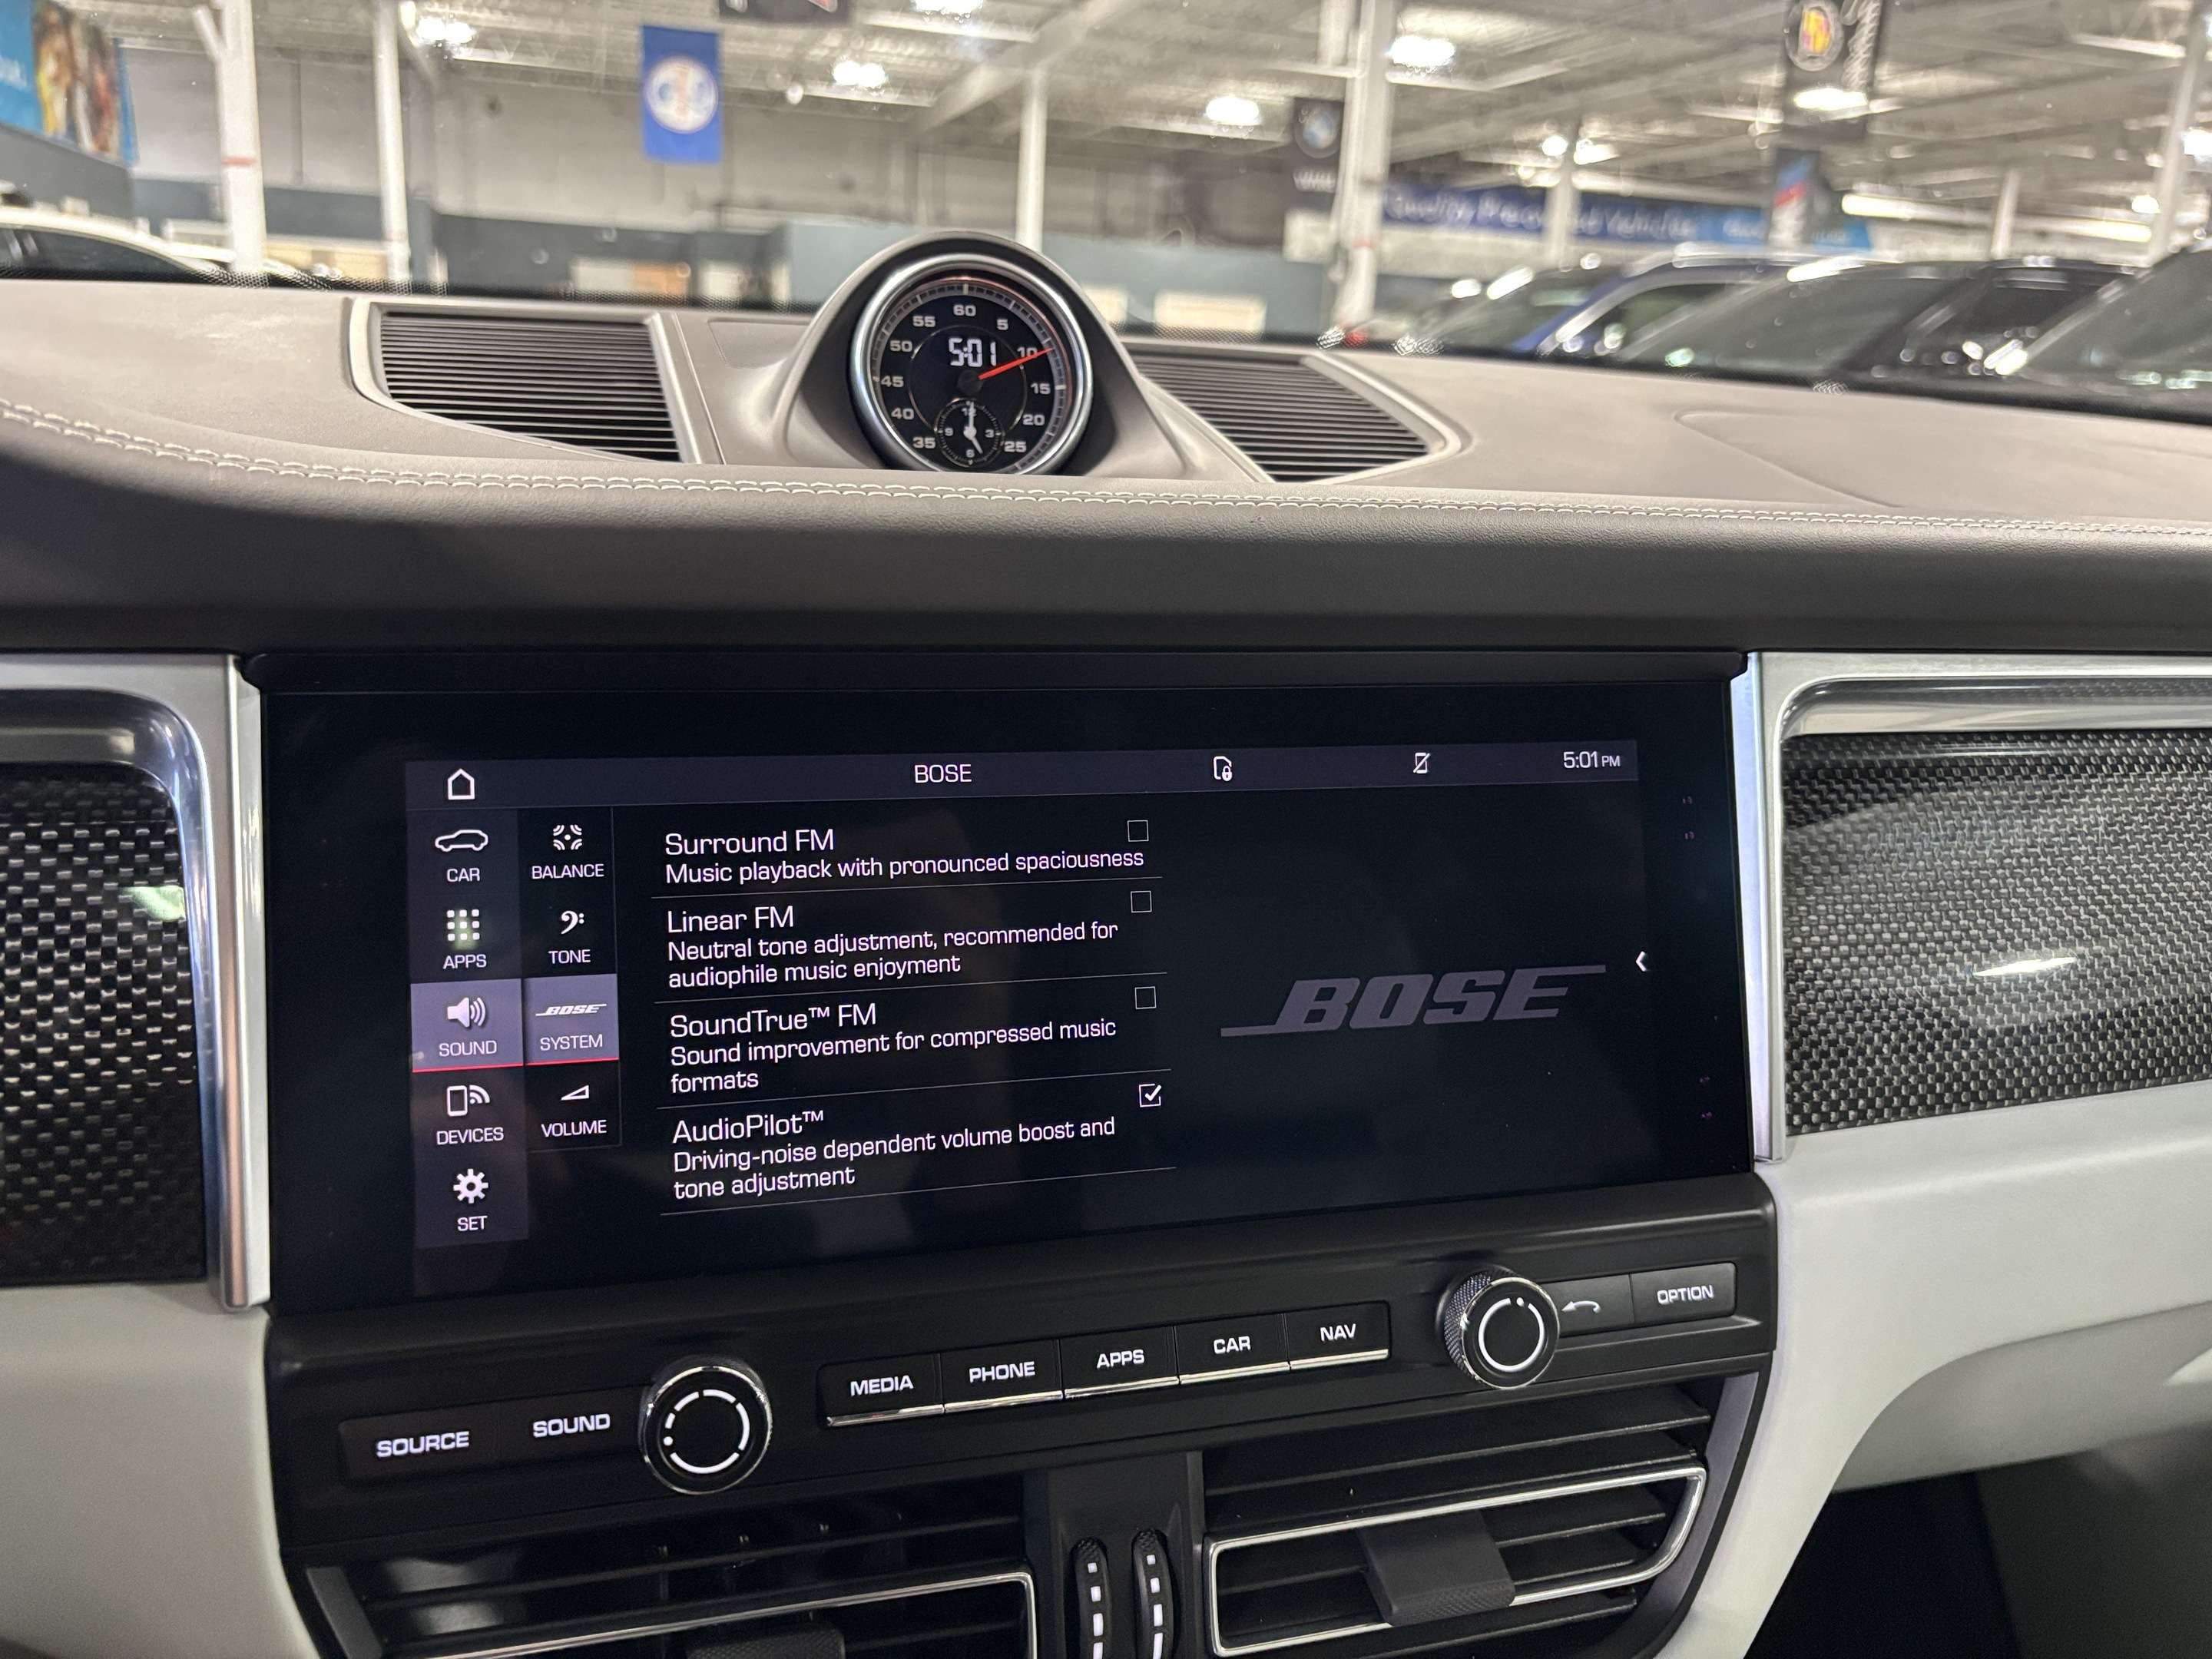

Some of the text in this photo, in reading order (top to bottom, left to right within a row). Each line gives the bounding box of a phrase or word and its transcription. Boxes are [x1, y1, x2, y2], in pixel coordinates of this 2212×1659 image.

[953, 304, 976, 317] 60
[912, 315, 936, 328] 55
[996, 318, 1008, 330] 5
[890, 340, 912, 352] 50
[949, 338, 997, 367] 5:01
[881, 376, 904, 387] 45
[1030, 382, 1051, 395] 15
[891, 407, 915, 420] 40
[1022, 413, 1045, 426] 20
[912, 436, 936, 449] 35
[985, 429, 994, 438] 3
[1005, 442, 1027, 452] 25
[1563, 750, 1621, 769] 5:01 PM
[914, 763, 972, 783] BOSE
[665, 828, 834, 856] Surround FM
[446, 867, 481, 882] CAR
[531, 863, 604, 879] BALANCE
[666, 850, 1144, 885] Music playback with pronounced spaciousness
[667, 905, 794, 933] Linear FM
[668, 921, 1118, 962] Neutral tone adjustment, recommended for
[442, 953, 487, 969] APPS
[548, 949, 591, 965] TONE
[668, 955, 961, 989] audiophile music enjoyment
[538, 1004, 605, 1015] BOSE
[1229, 965, 1601, 1035] BOSE
[838, 1002, 876, 1027] FM
[439, 1040, 497, 1057] SOUND
[539, 1033, 603, 1051] SYSTEM
[671, 1018, 1116, 1066] Sound improvement for compressed music
[671, 1071, 759, 1094] formats
[436, 1126, 505, 1145] DEVICES
[541, 1119, 608, 1137] VOLUME
[673, 1116, 1115, 1175] Driving-noise dependent volume boost and
[673, 1164, 856, 1200] tone adjustment
[457, 1215, 488, 1232] SET
[1657, 1284, 1714, 1305] OPTION
[1320, 1323, 1356, 1342] NAV
[1213, 1336, 1251, 1355] CAR
[1096, 1349, 1145, 1369] APPS
[969, 1361, 1036, 1383] PHONE
[850, 1375, 914, 1396] MEDIA
[532, 1413, 611, 1438] SOUND
[376, 1431, 469, 1458] SOURCE
